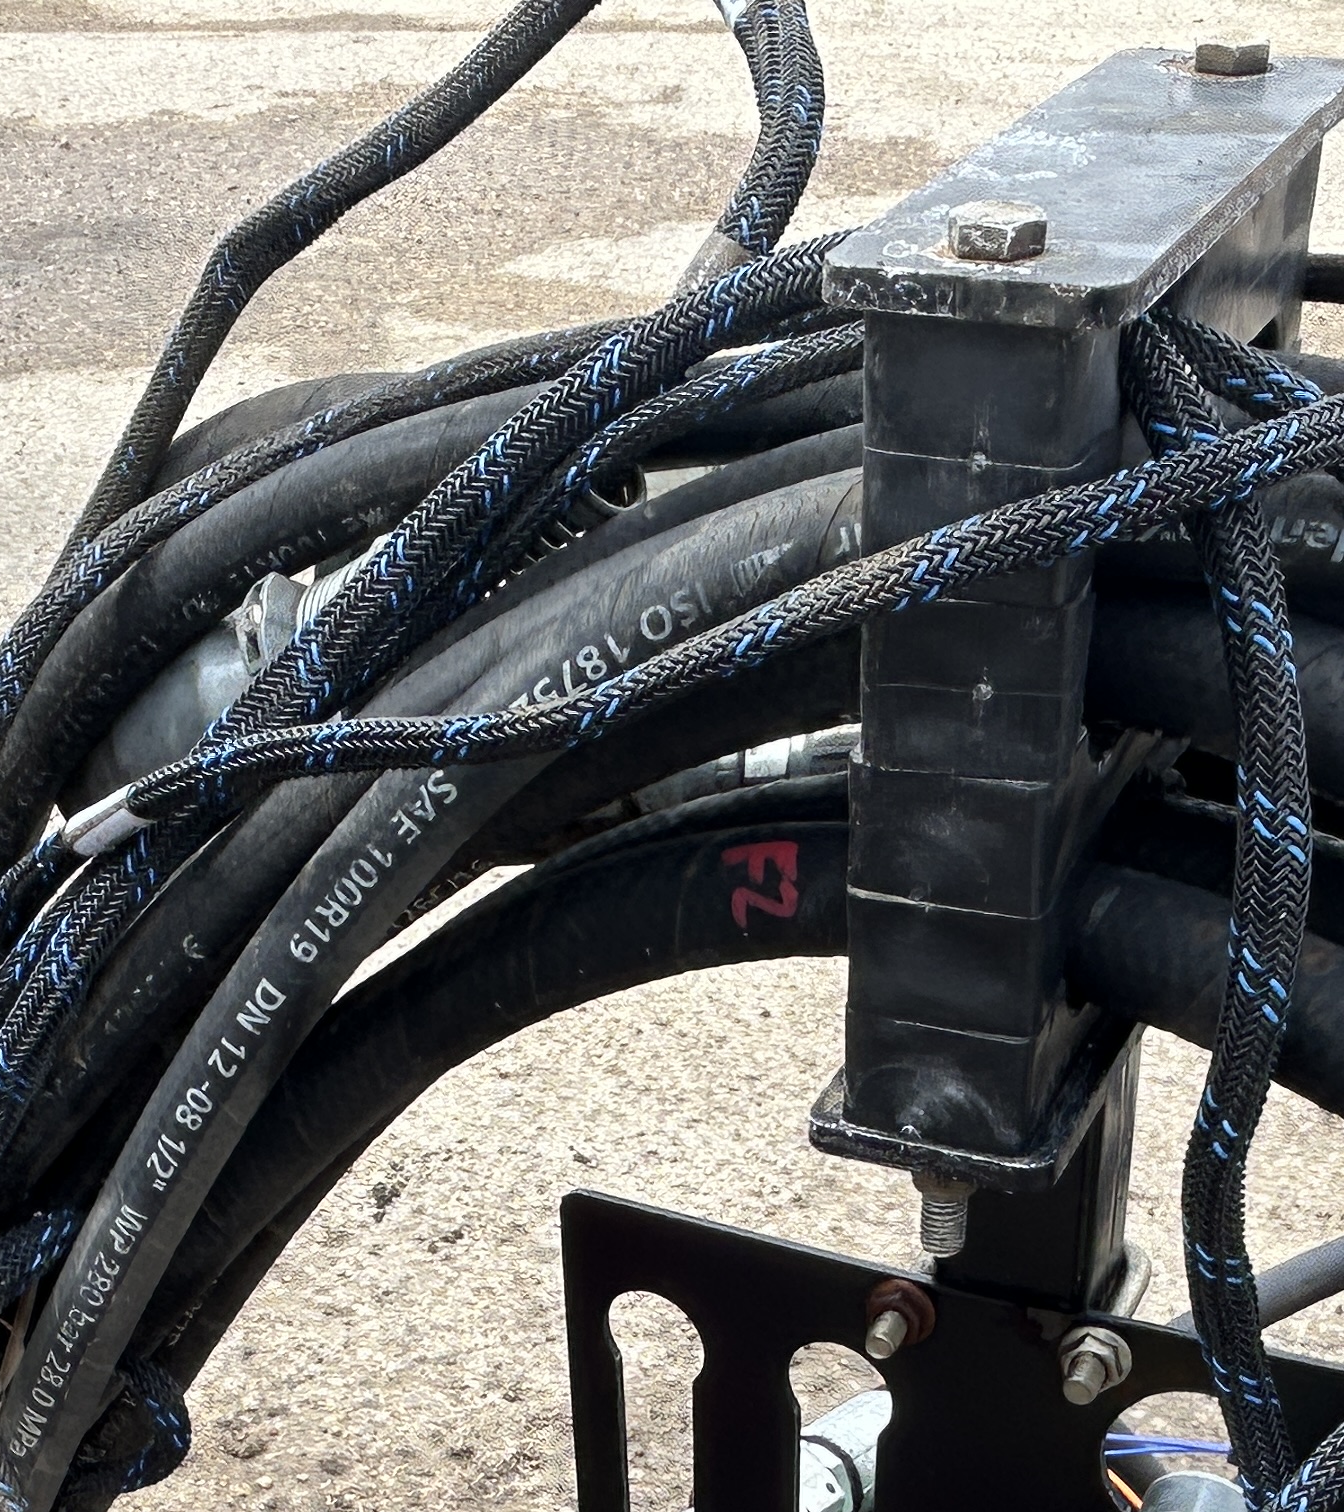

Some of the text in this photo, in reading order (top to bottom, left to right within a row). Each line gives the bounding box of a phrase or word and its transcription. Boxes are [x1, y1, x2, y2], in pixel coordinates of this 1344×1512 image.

[639, 578, 713, 642] ISO
[390, 768, 458, 845] SAE
[289, 842, 393, 964] 100R19
[235, 976, 288, 1036] DN
[146, 1133, 187, 1192] 1/2"
[108, 1203, 149, 1255] WP
[79, 1250, 121, 1307] 280
[56, 1303, 99, 1354] bar
[31, 1348, 72, 1409] 28.0
[8, 1405, 49, 1458] MPa
